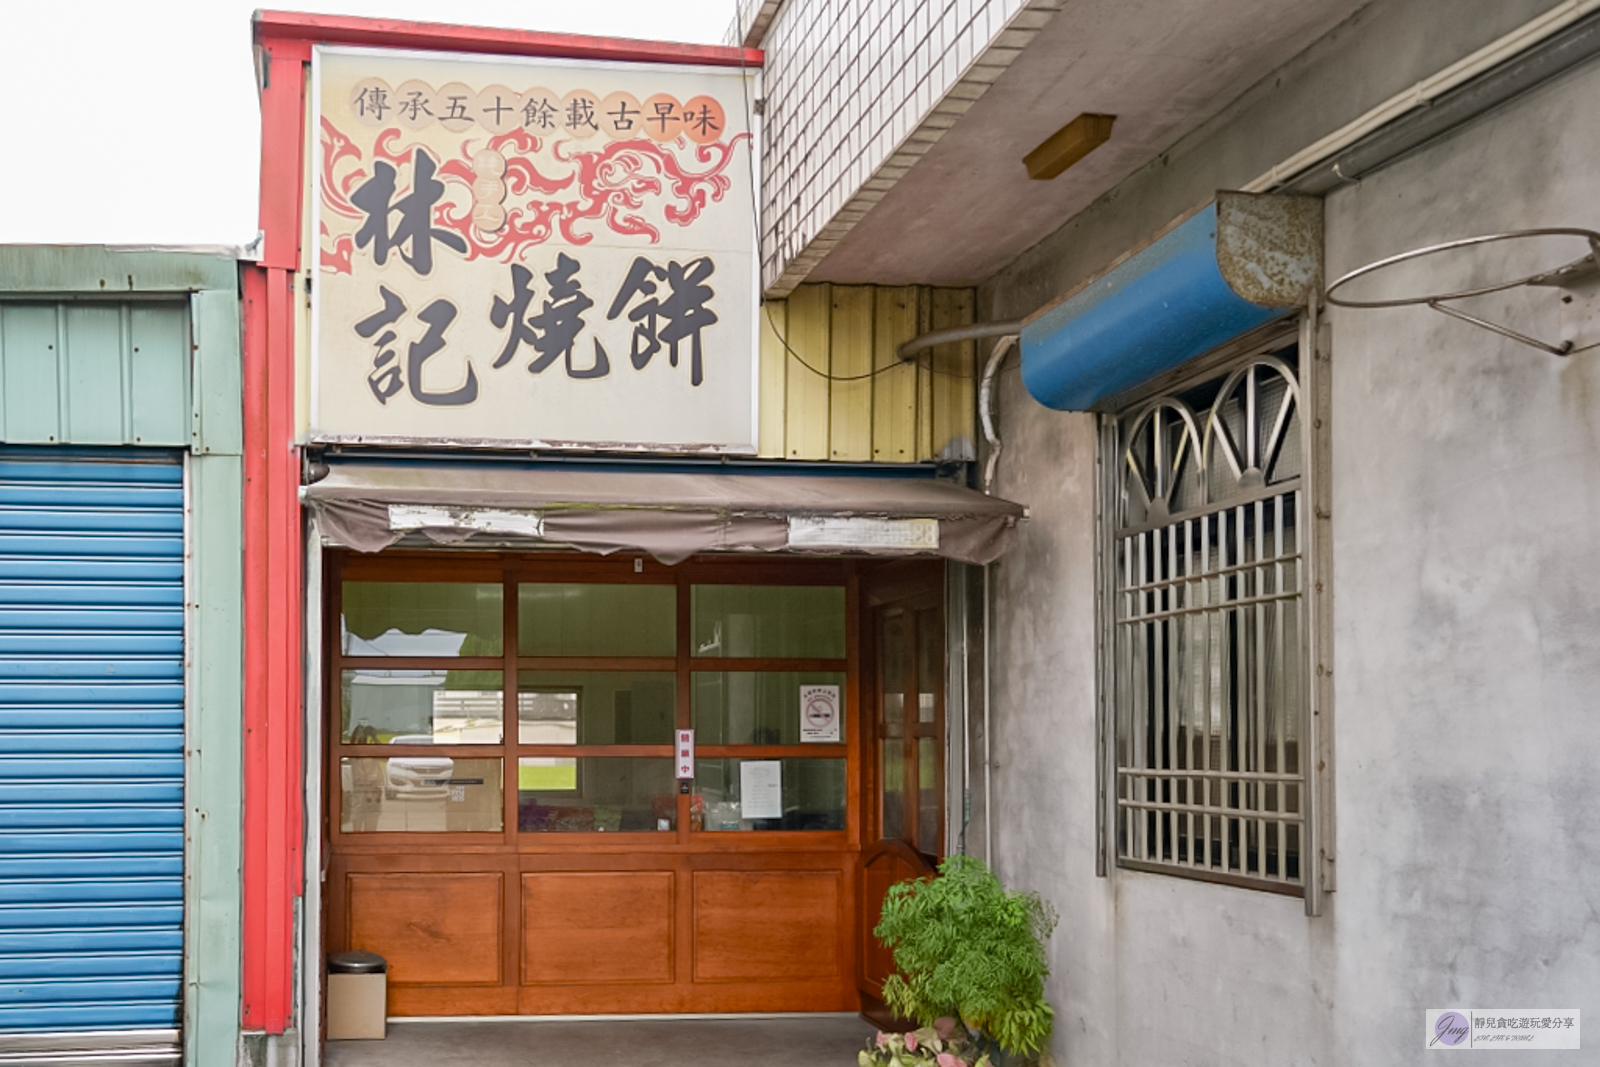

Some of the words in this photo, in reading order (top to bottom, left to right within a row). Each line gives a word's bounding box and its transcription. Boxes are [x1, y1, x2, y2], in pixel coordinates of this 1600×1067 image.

[354, 87, 720, 136] 傳承五十餘載古早味
[350, 147, 478, 406] 林記
[490, 252, 718, 386] 燒餅
